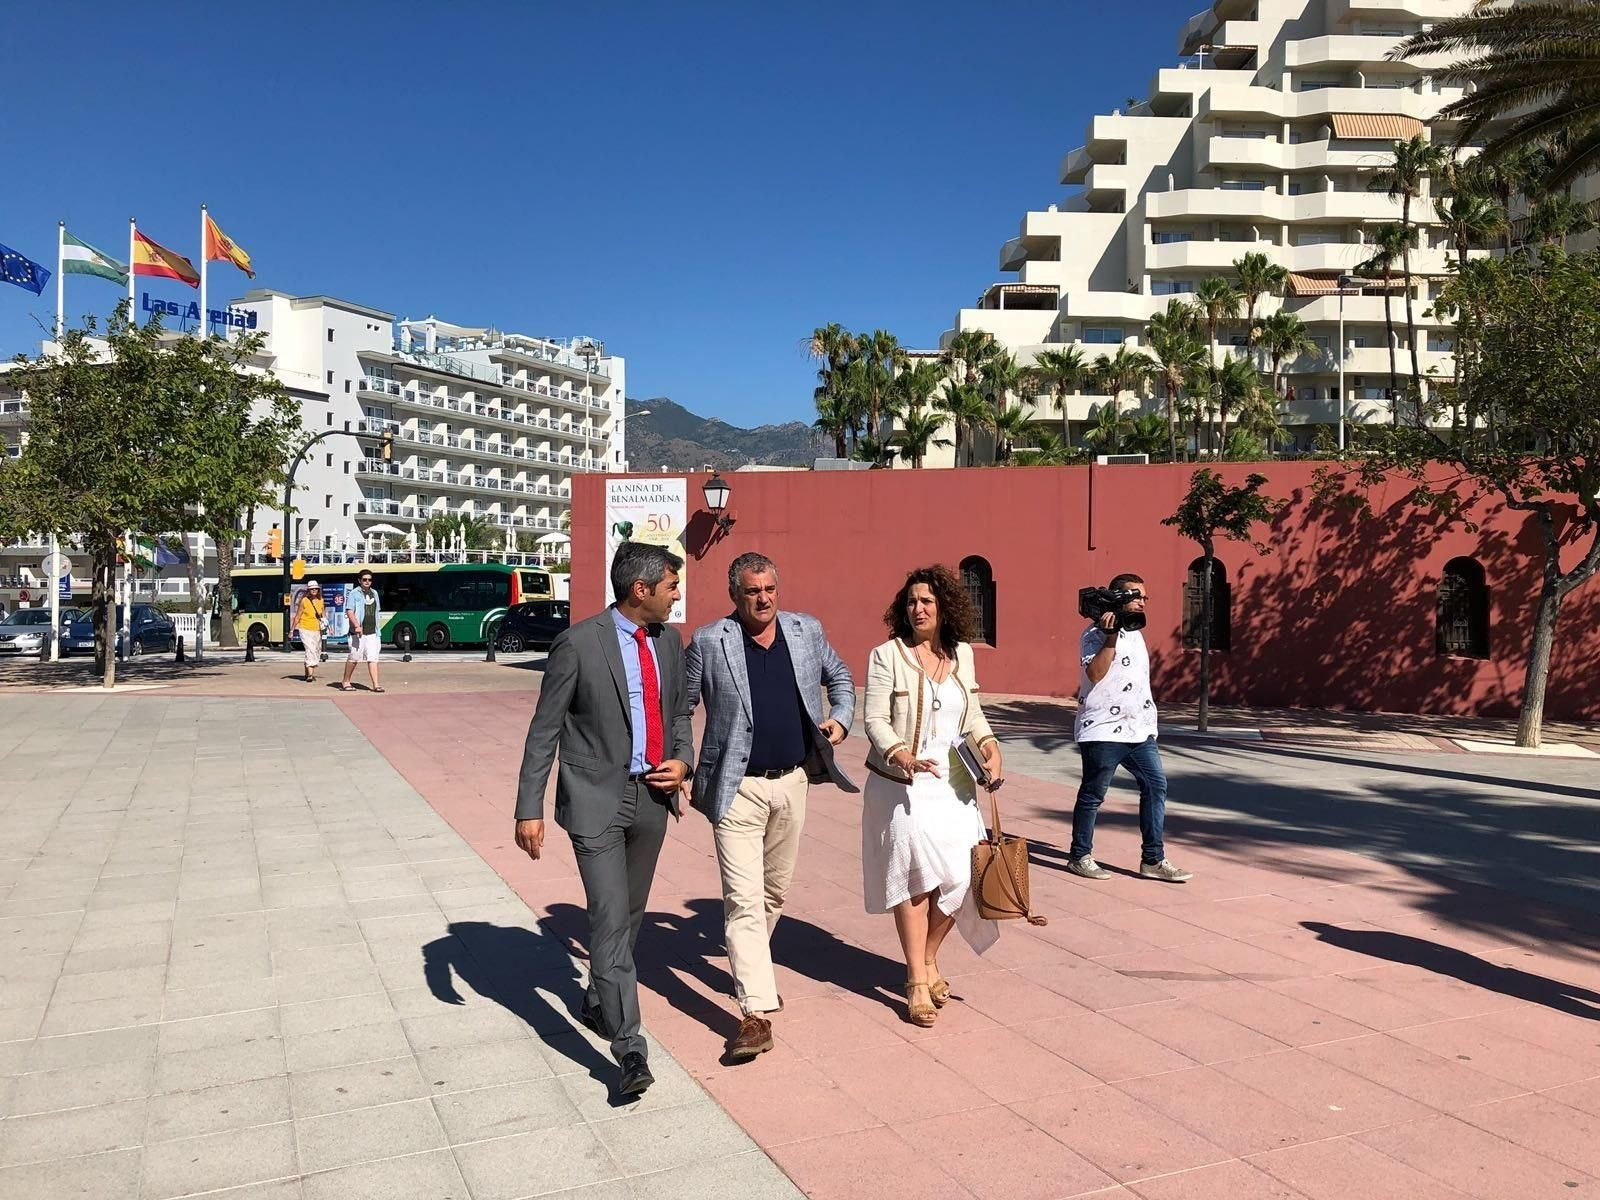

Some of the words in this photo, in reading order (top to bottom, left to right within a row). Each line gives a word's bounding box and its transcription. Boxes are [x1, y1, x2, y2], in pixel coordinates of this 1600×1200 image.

[142, 292, 179, 316] Las
[611, 484, 622, 493] LA
[651, 484, 664, 493] DE
[647, 513, 671, 532] 50
